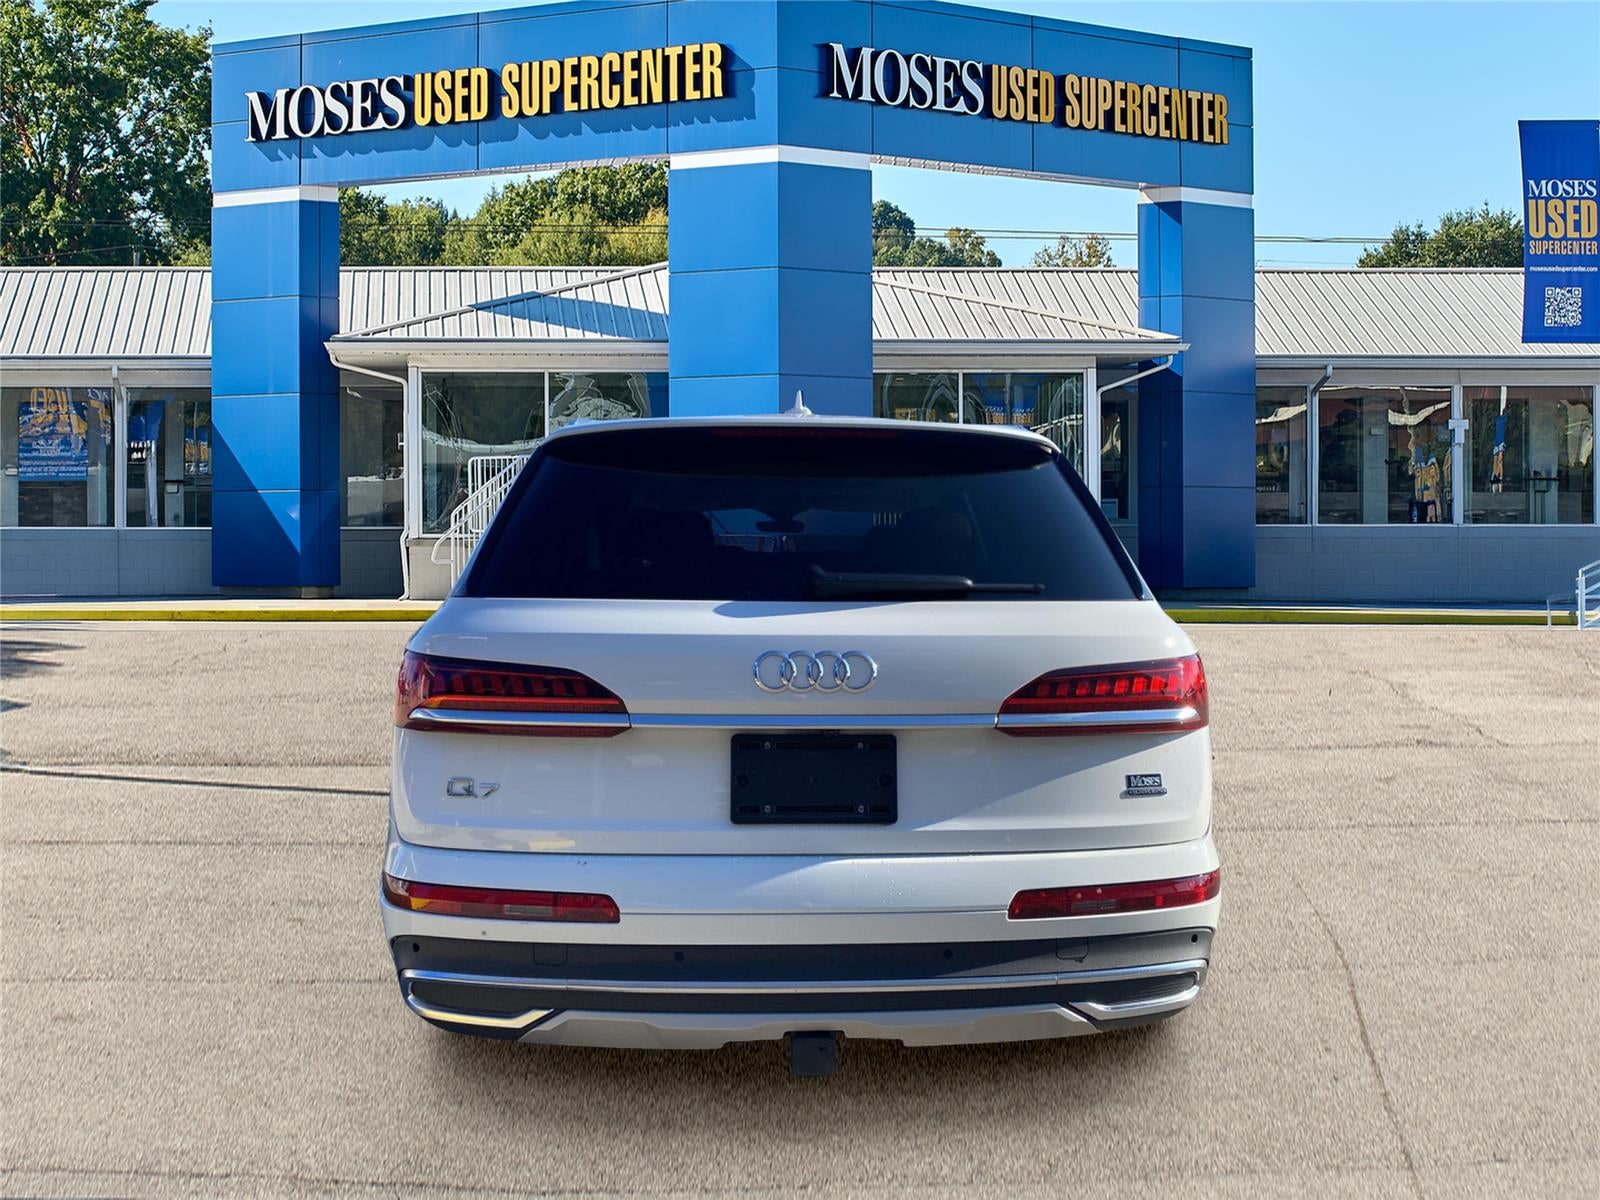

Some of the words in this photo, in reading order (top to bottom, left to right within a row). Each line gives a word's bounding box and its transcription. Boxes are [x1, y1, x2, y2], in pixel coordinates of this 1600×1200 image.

[243, 75, 407, 142] MOSES
[413, 66, 490, 127] USED
[500, 42, 725, 118] SUPERCENTER
[828, 42, 985, 116] MOSES
[991, 64, 1055, 124] USED
[1064, 73, 1230, 145] SUPERCENTER
[1527, 179, 1597, 198] MOSES
[1528, 199, 1599, 239] USED
[1529, 240, 1599, 255] SUPERCENTER
[446, 776, 501, 800] Q7
